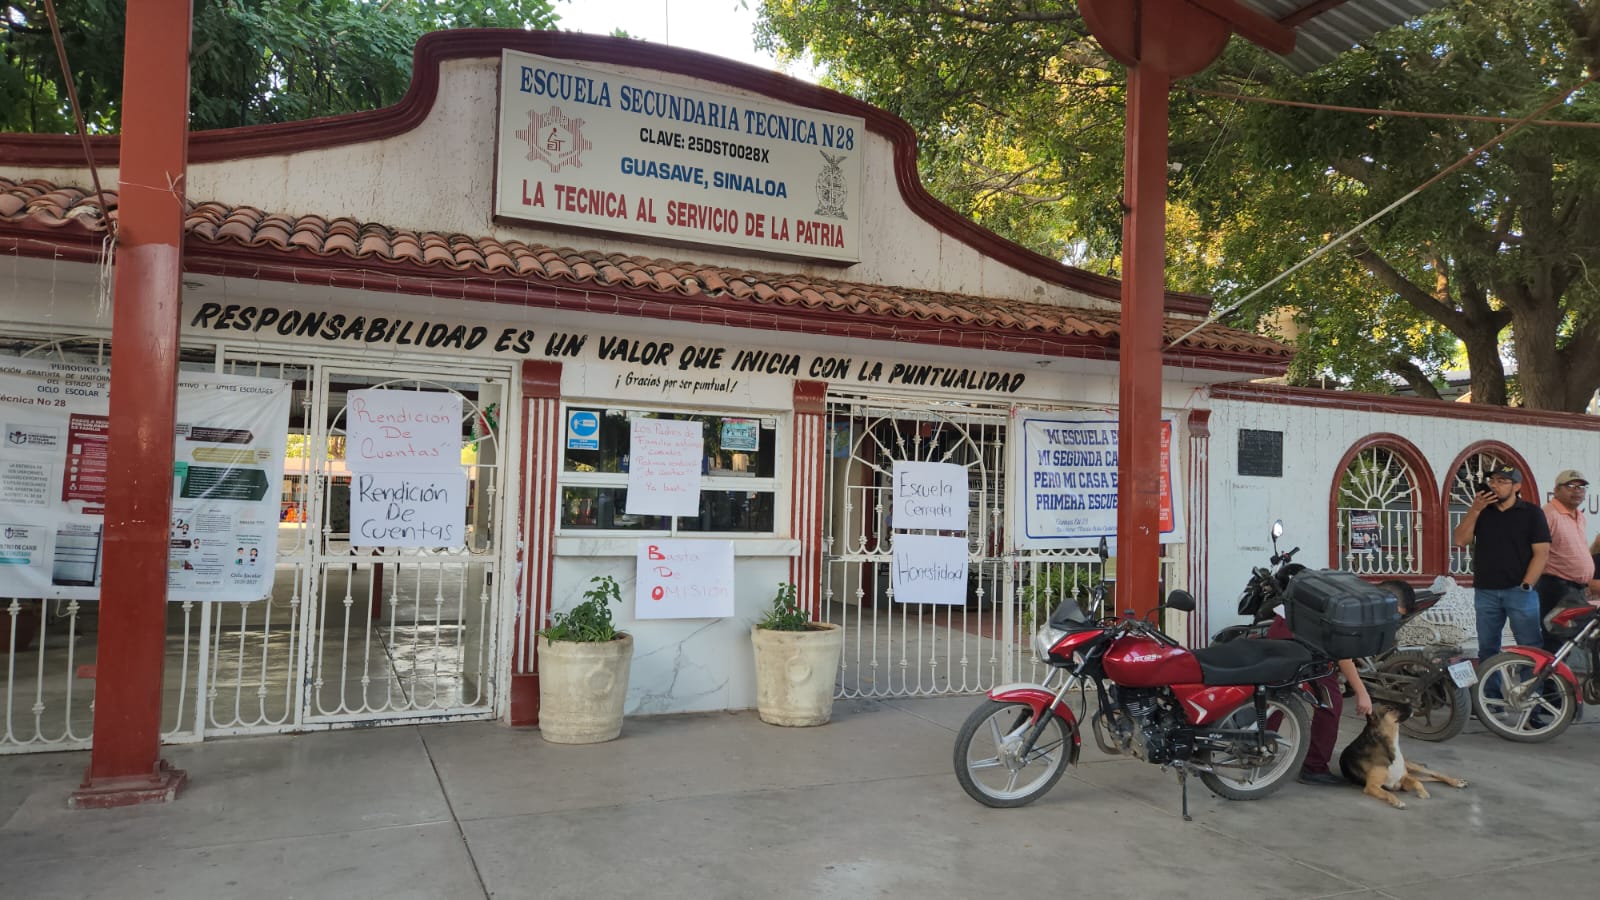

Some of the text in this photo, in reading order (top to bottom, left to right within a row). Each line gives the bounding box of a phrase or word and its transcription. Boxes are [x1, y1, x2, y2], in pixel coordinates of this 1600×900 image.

[520, 65, 612, 109] ESCUELA
[619, 85, 741, 132] SECUNDARIA
[744, 109, 819, 147] TECNICA
[639, 127, 685, 150] CLAVE:
[620, 156, 788, 199] GUASAVE, SINALOA
[522, 179, 845, 249] LA TECNICA AL SERVICIO DE LA PATRIA
[191, 302, 1026, 394] RESPONSABILIDAD ES UN VALOR QUE INICIA CON LA PUNTUALIDAD
[37, 385, 59, 394] CICLO
[65, 388, 99, 397] ESCOLAR
[662, 378, 677, 393] por
[679, 379, 692, 390] ser
[0, 393, 66, 407] écnica No 28
[380, 425, 413, 440] De
[1063, 429, 1110, 445] ESCUELA
[1112, 430, 1119, 445] E
[1038, 450, 1118, 467] MI SEGUNDA CA
[359, 475, 448, 503] Rendición
[899, 471, 953, 498] Escuela
[1034, 471, 1118, 488] PERO MI CASA E
[386, 502, 415, 522] De
[905, 499, 952, 518] Cerrada
[1036, 494, 1118, 511] PRIMERA ESCUE
[361, 518, 453, 541] Cuentas
[648, 545, 701, 562] Basta
[653, 566, 680, 580] De
[897, 552, 964, 585] Honestidad
